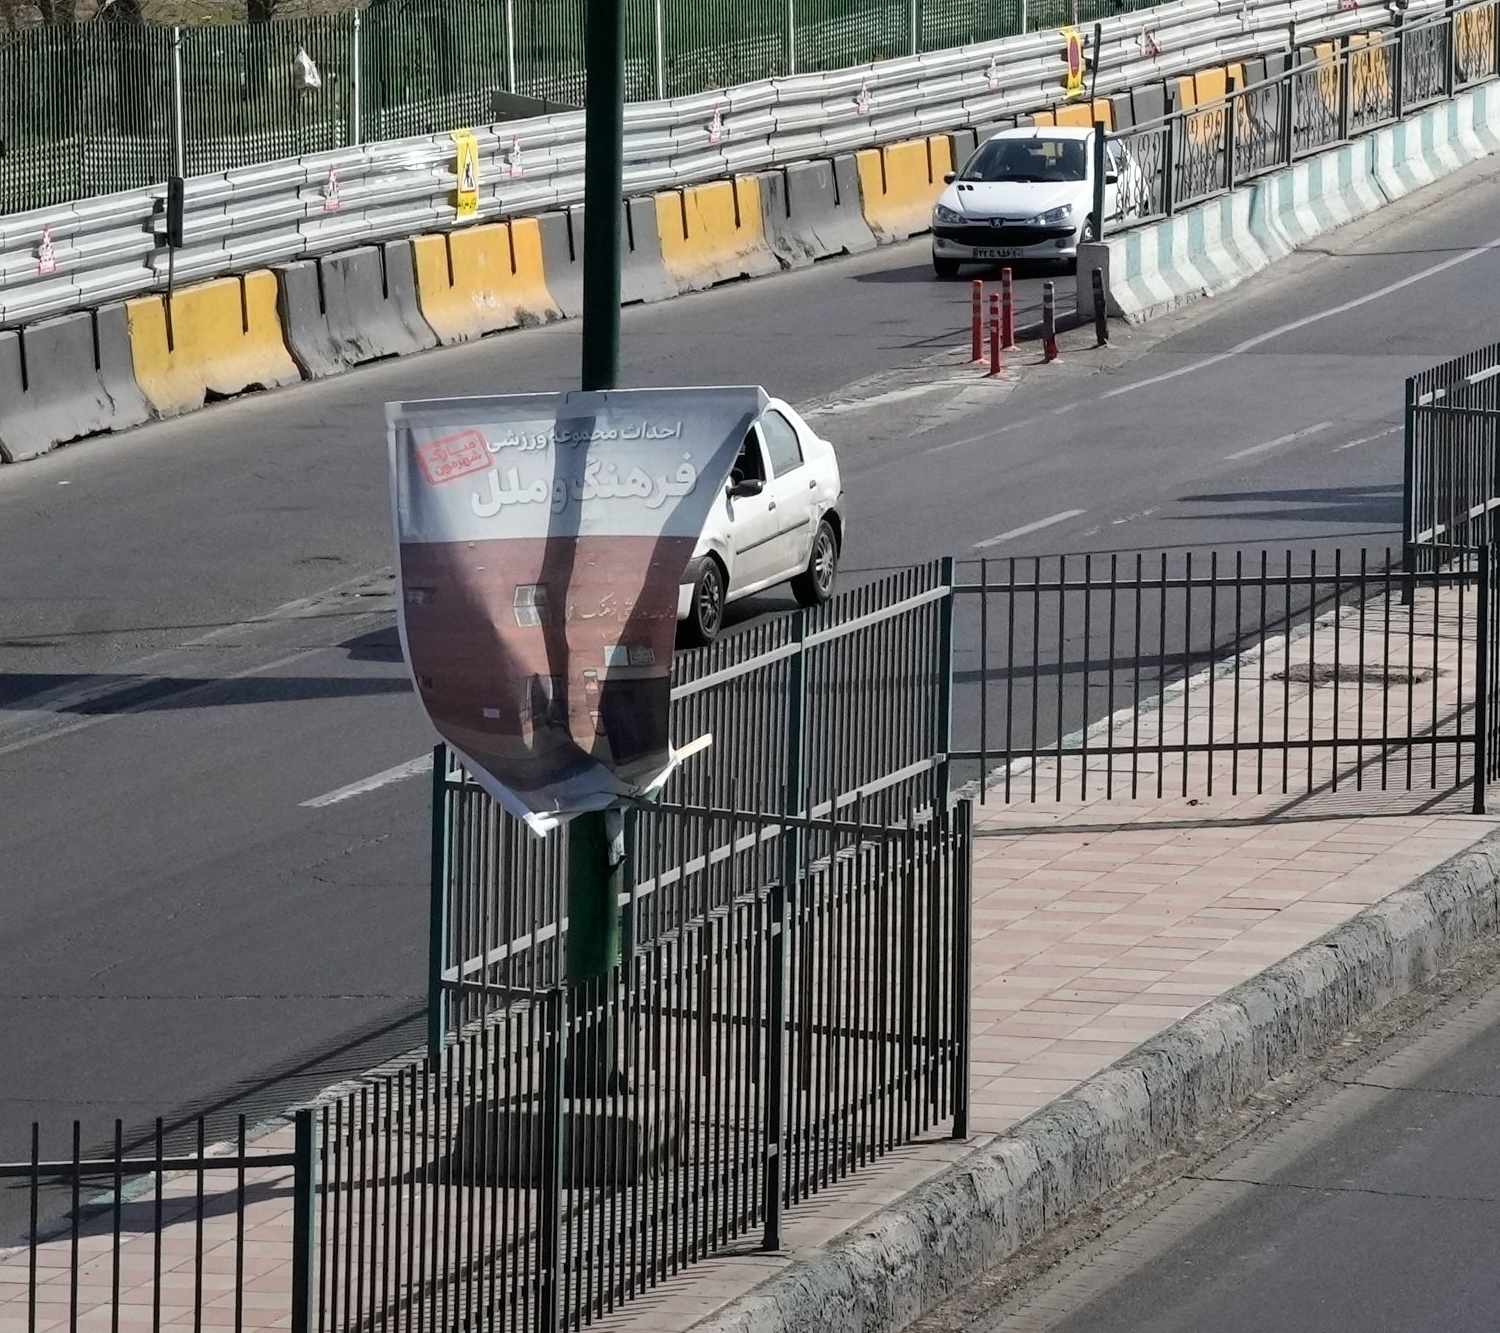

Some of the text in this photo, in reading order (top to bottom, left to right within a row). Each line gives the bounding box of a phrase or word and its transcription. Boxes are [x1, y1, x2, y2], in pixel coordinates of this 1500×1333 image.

[487, 421, 683, 453] احداث مجموعه ورزشی
[471, 452, 698, 517] فرهنگ و ملل
